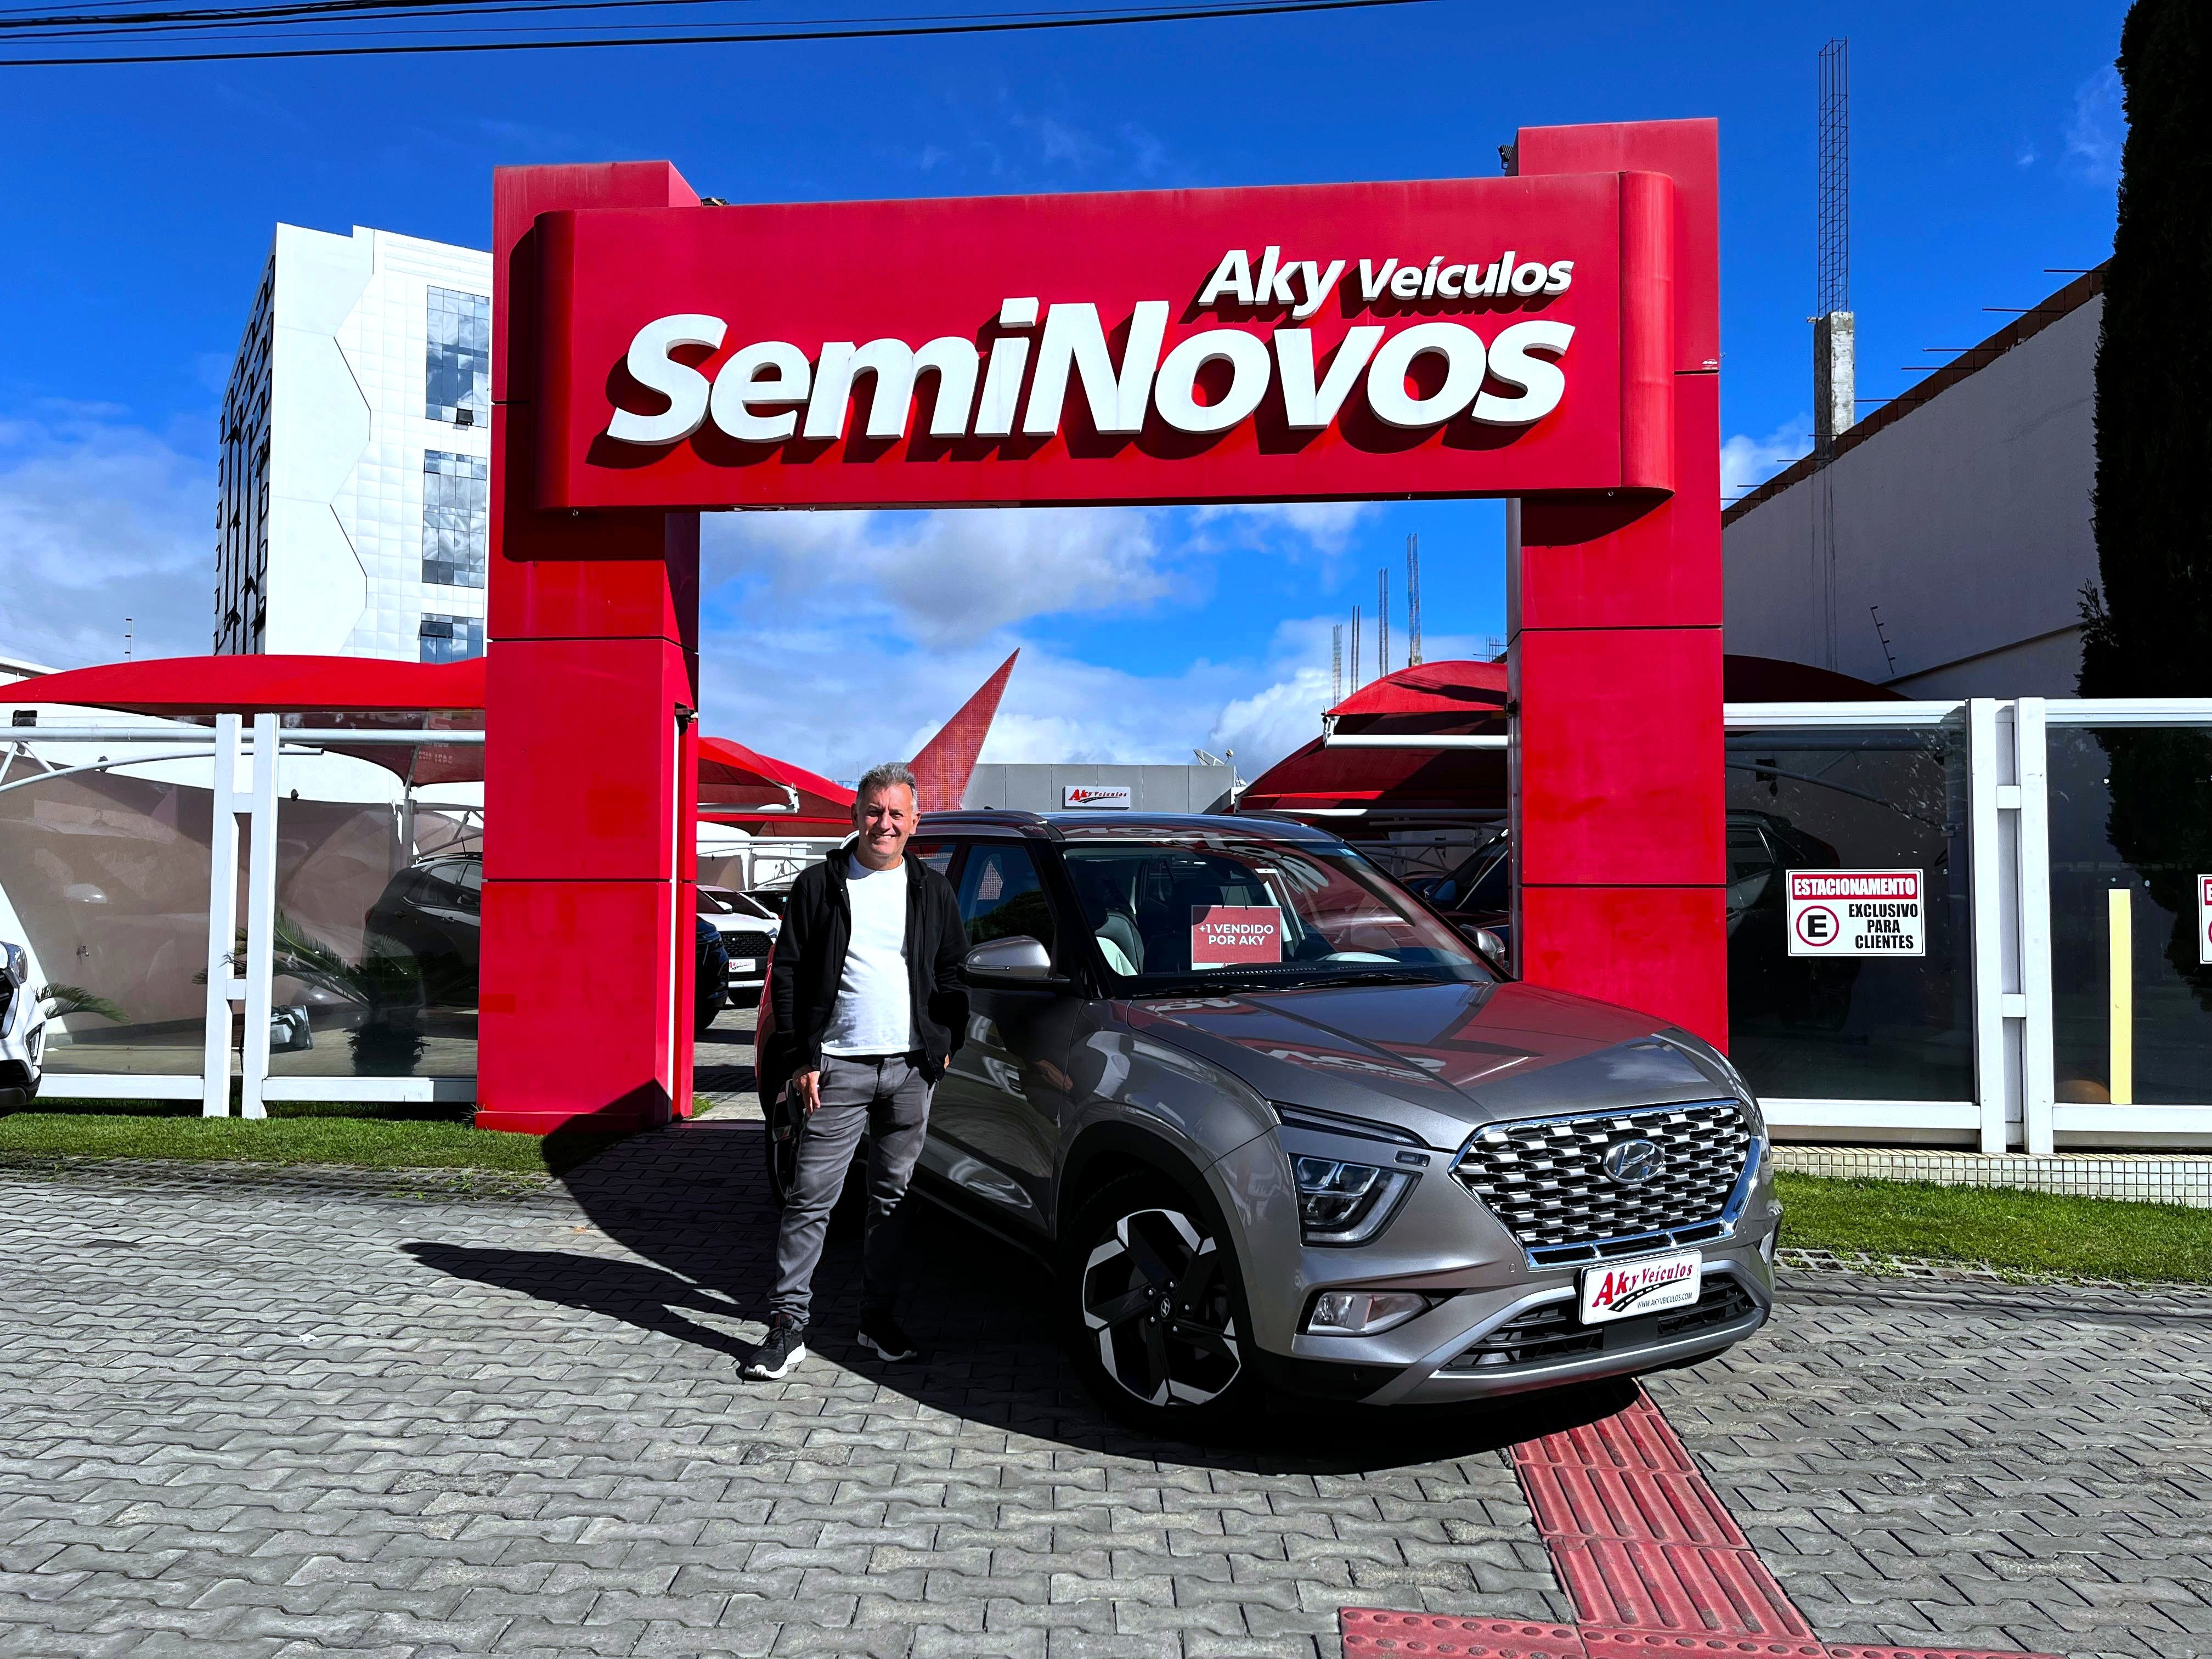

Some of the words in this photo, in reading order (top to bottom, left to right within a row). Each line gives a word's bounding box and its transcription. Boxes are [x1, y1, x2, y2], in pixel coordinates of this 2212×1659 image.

[1198, 245, 1346, 320] Aky
[1359, 251, 1575, 301] Veículos
[605, 297, 1576, 445] SemiNovos
[1793, 877, 1915, 896] ESTACIONAMENTO
[1848, 904, 1918, 918] EXCLUSIVO
[1199, 924, 1211, 934] +1
[1214, 924, 1274, 934] VENDIDO
[1807, 915, 1828, 938] E
[1867, 919, 1900, 933] PARA
[1209, 935, 1235, 945] POR
[1238, 935, 1266, 945] AKY
[1855, 934, 1914, 949] CLIENTES
[1592, 1270, 1640, 1308] Aky
[1642, 1262, 1693, 1284] Veículos
